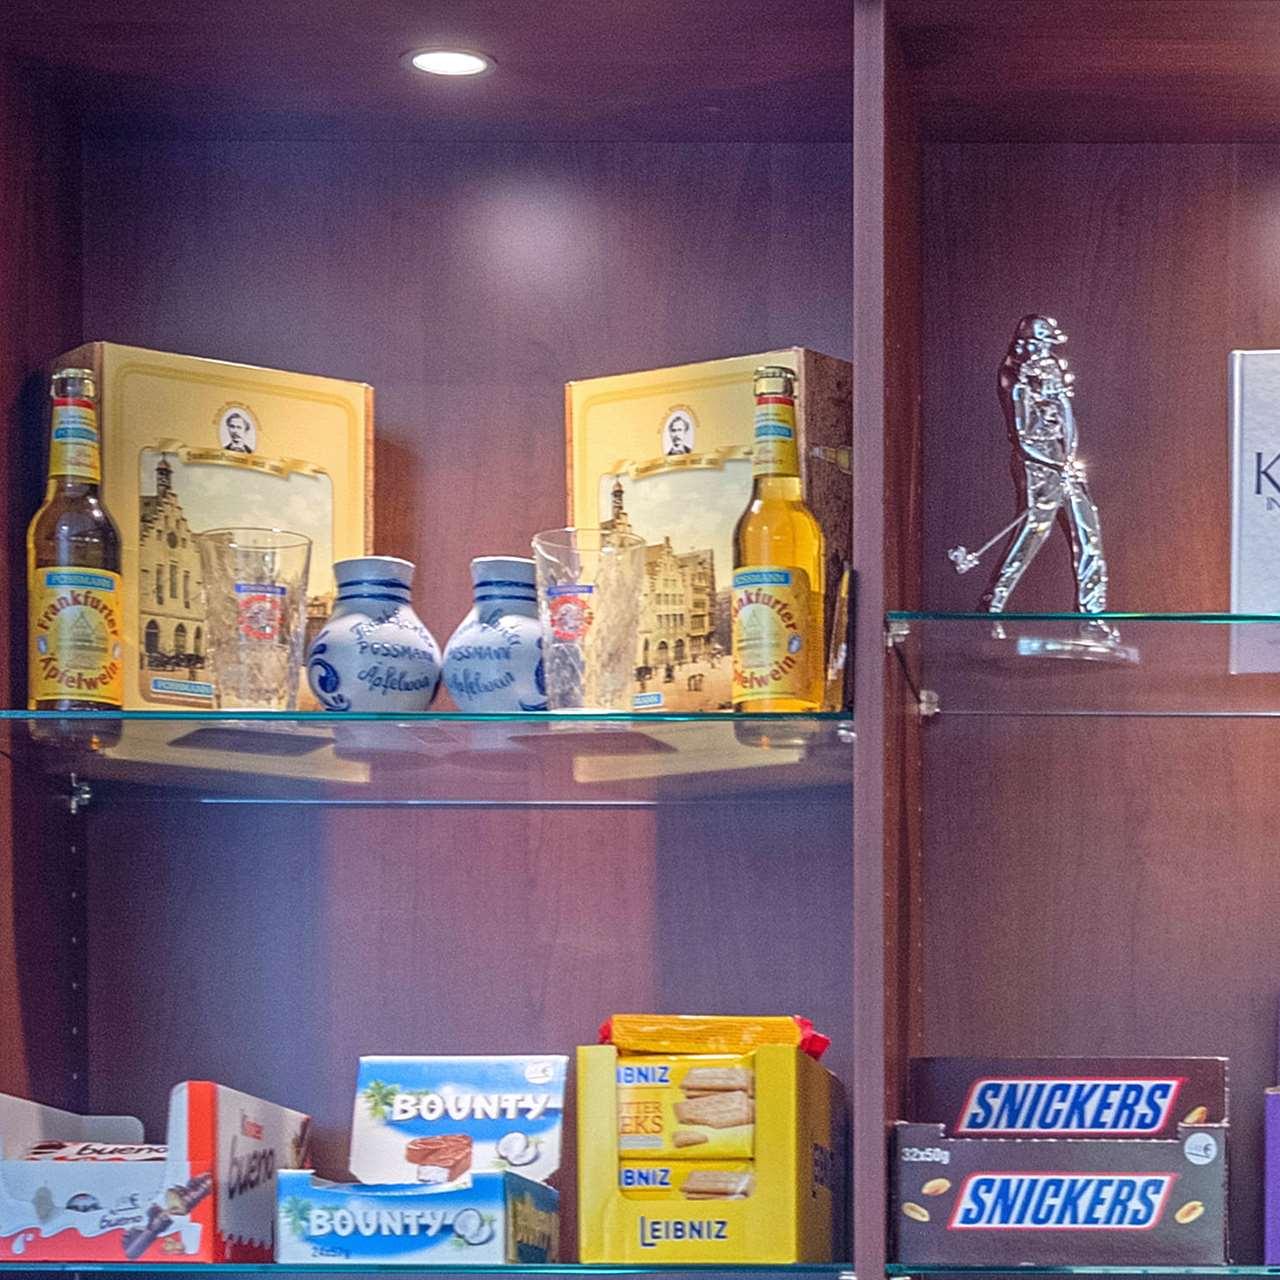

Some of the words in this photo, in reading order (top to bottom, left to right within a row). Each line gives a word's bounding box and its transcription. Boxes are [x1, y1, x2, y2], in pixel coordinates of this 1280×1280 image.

[390, 1094, 549, 1121] BOUNTY
[966, 1083, 1173, 1129] SNICKERS
[620, 1116, 663, 1134] EKS
[959, 1178, 1165, 1225] SNICKERS
[308, 1209, 446, 1237] BOUNTY
[640, 1216, 727, 1246] LEIBNIZ
